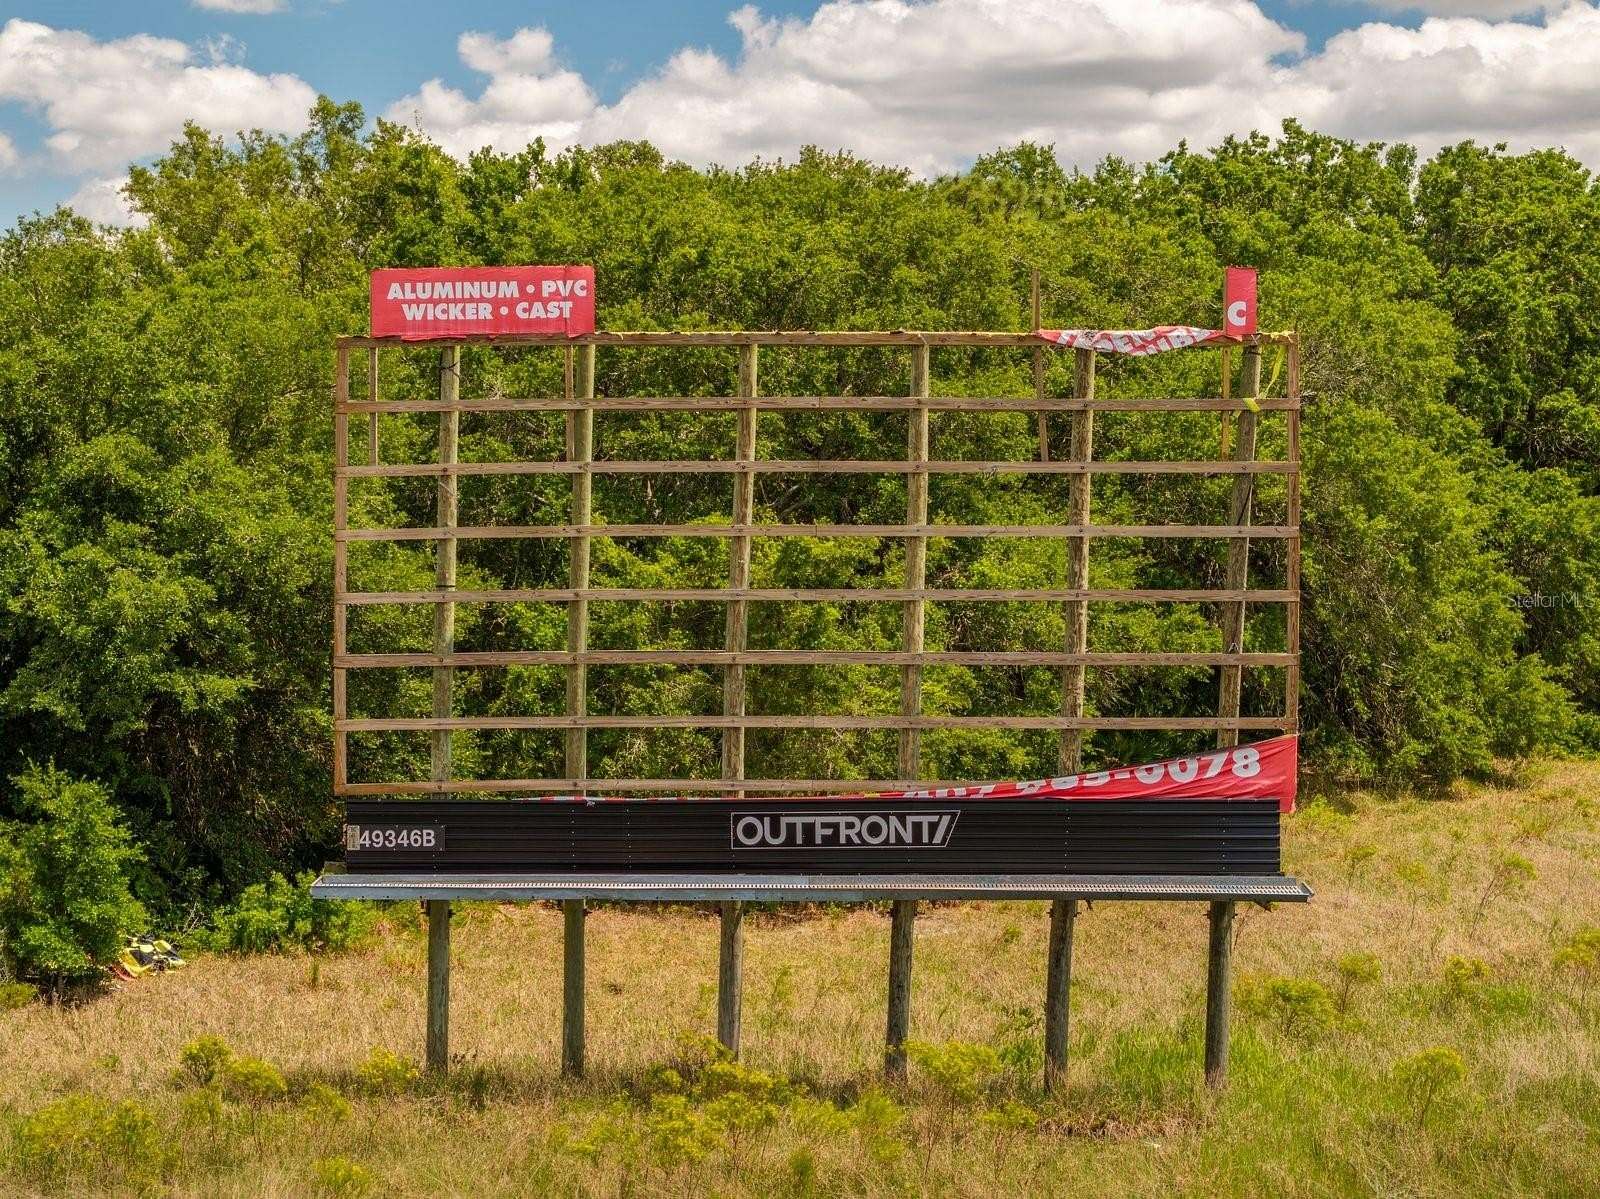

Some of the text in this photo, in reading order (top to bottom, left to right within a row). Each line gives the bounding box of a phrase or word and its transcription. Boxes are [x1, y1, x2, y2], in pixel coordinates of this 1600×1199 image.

[387, 279, 587, 299] ALUMINUM PVC
[402, 302, 573, 321] WICKER CAST
[360, 829, 436, 848] 49346B
